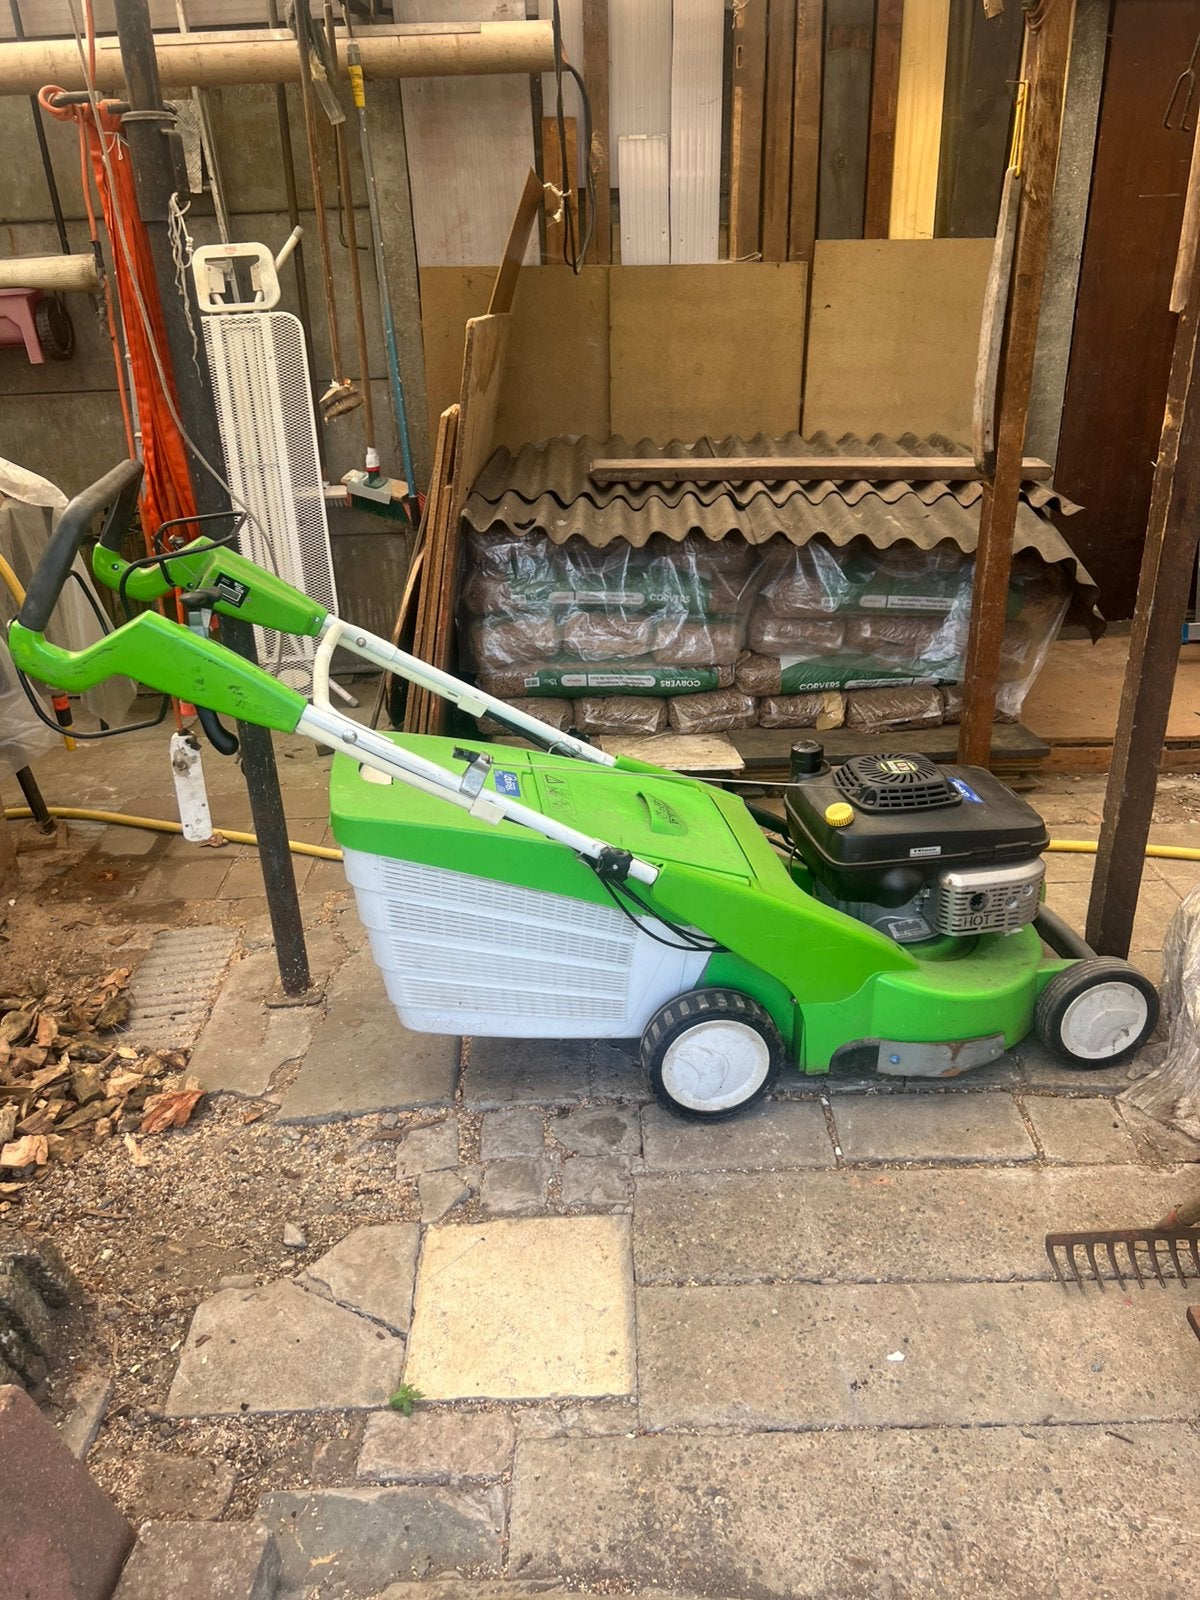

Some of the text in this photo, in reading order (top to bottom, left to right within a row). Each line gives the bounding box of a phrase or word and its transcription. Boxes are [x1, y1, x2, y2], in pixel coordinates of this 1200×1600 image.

[660, 678, 701, 688] CORVERS
[799, 680, 841, 691] CORVERS
[963, 914, 991, 927] HOT
